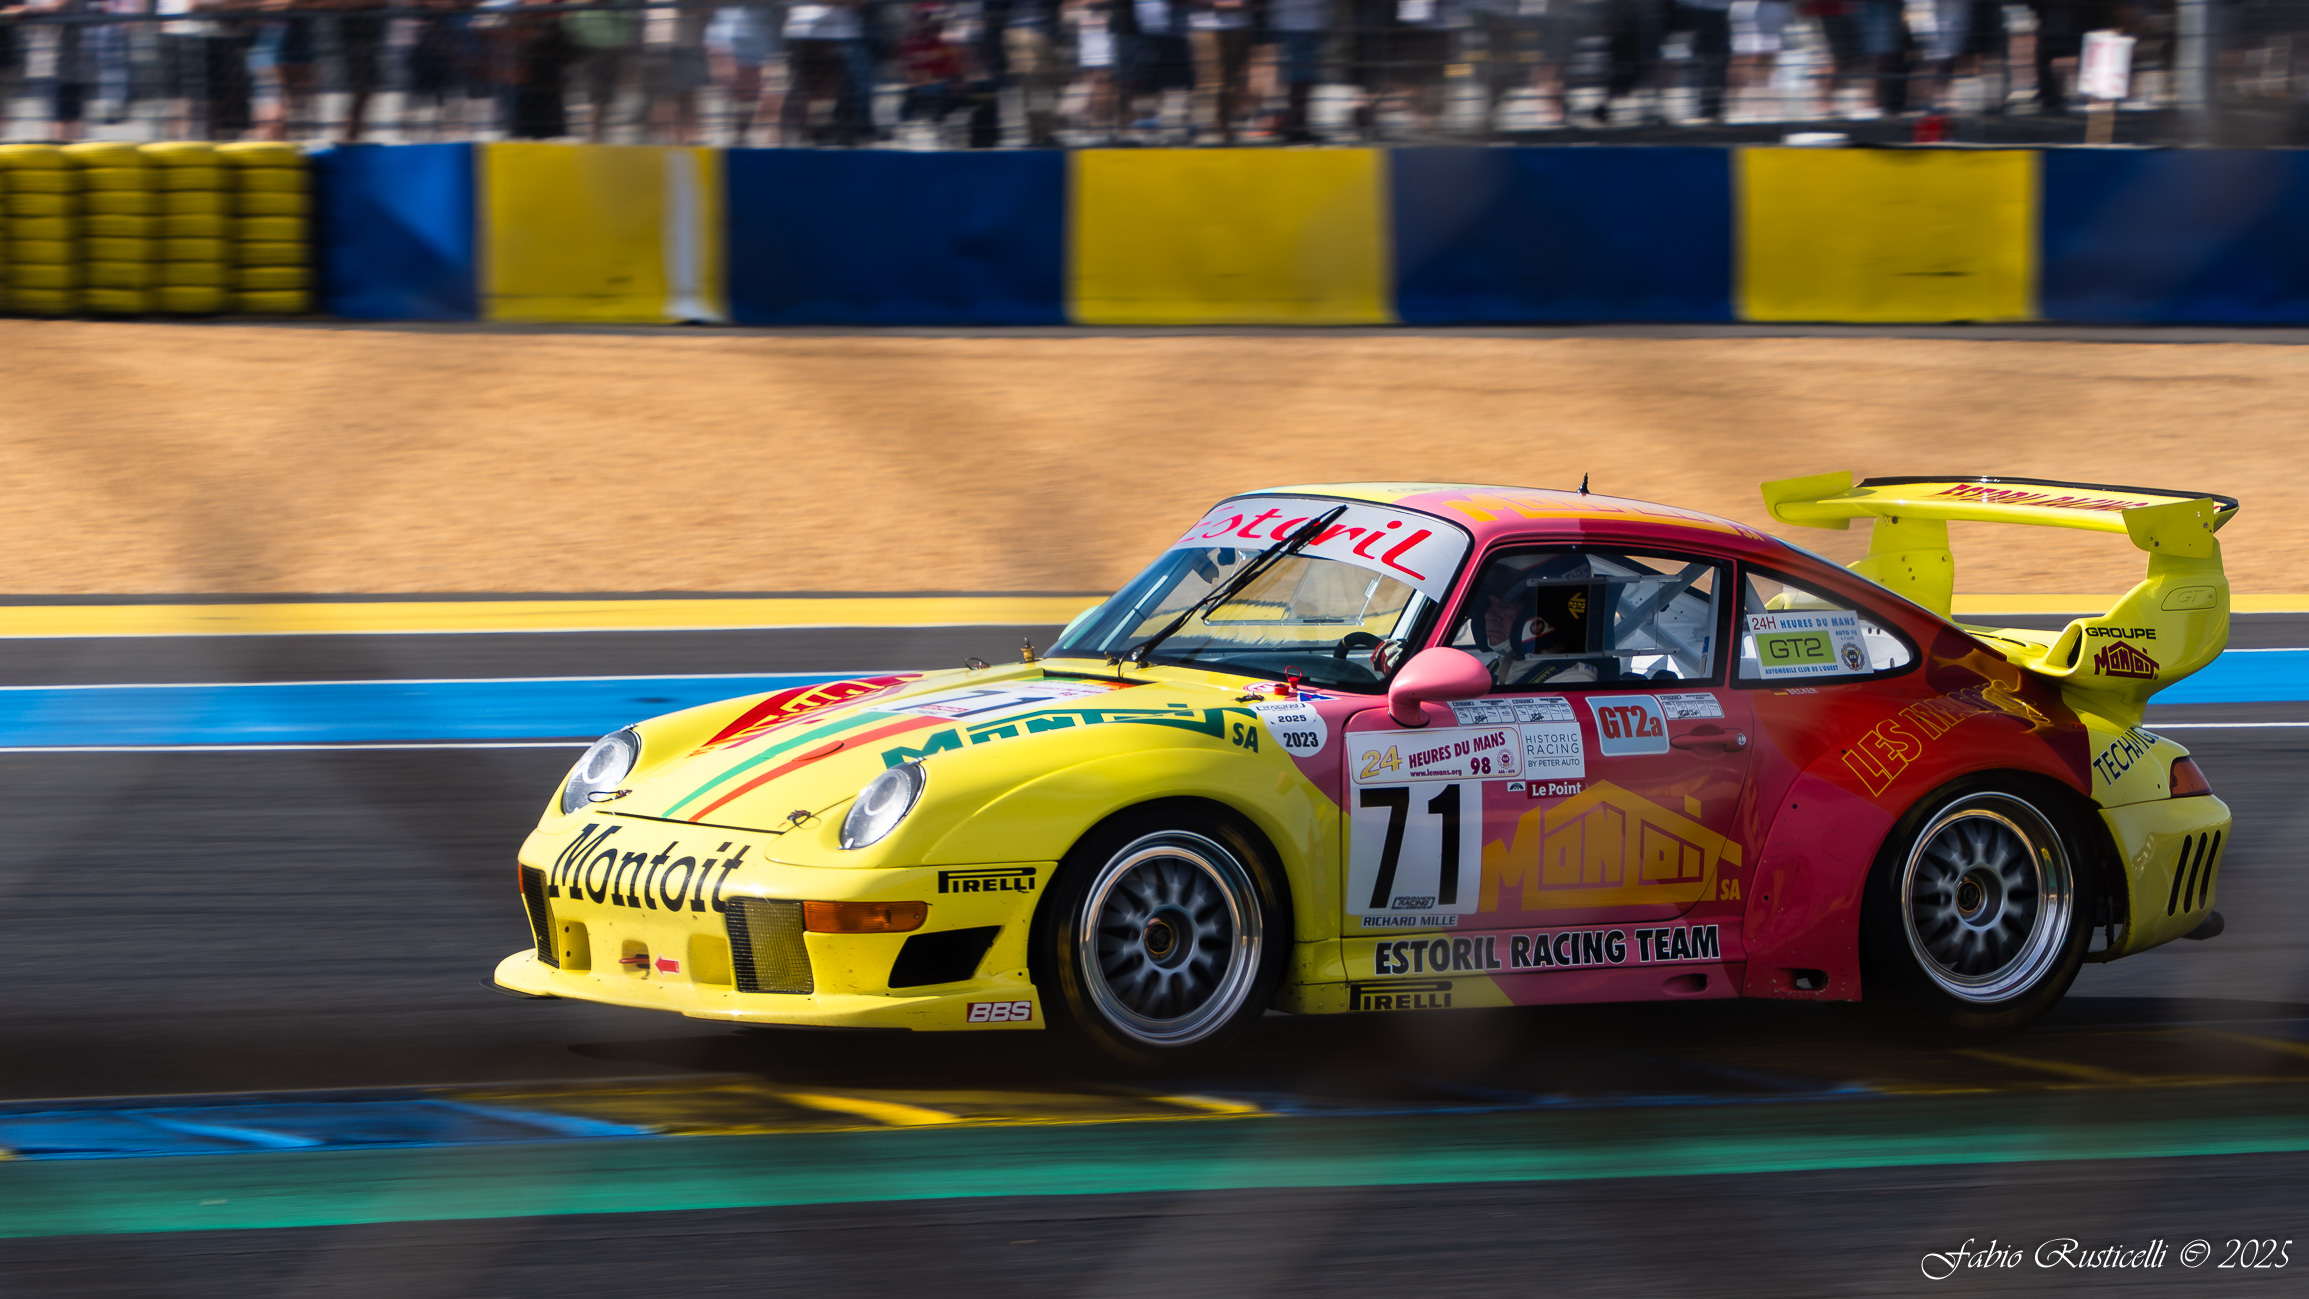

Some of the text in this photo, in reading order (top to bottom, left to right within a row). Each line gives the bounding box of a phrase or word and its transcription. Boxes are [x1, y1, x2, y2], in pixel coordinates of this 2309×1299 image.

[1752, 616, 1855, 630] 24H HEURES DU MANS
[2085, 627, 2157, 640] GROUPE
[1769, 638, 1824, 658] GT2
[1765, 666, 1797, 675] AUTOMOBILE
[1277, 715, 1307, 723] 2025
[1597, 705, 1663, 740] GT2a
[1232, 722, 1258, 754] SA
[1283, 732, 1319, 748] 2023
[1525, 733, 1578, 744] HISTORIC
[1360, 731, 1506, 779] 24 HEURES DU MANS
[1527, 743, 1580, 755] RACING
[1841, 718, 1922, 798] LES
[1470, 756, 1491, 775] 98
[1528, 758, 1580, 767] BY PETER AUTO
[1410, 768, 1462, 778] www.lemans.org
[1531, 784, 1547, 797] Le
[1548, 781, 1582, 796] Point
[1359, 784, 1461, 909] 71
[548, 823, 752, 913] Montoit
[938, 867, 1037, 894] PIRELLI
[1720, 878, 1741, 900] SA
[1363, 915, 1457, 928] RICHARD MILLE
[1374, 924, 1721, 976] ESTORIL RACING TEAM
[1349, 981, 1453, 1011] PIRELLI
[968, 1001, 1031, 1022] BBS
